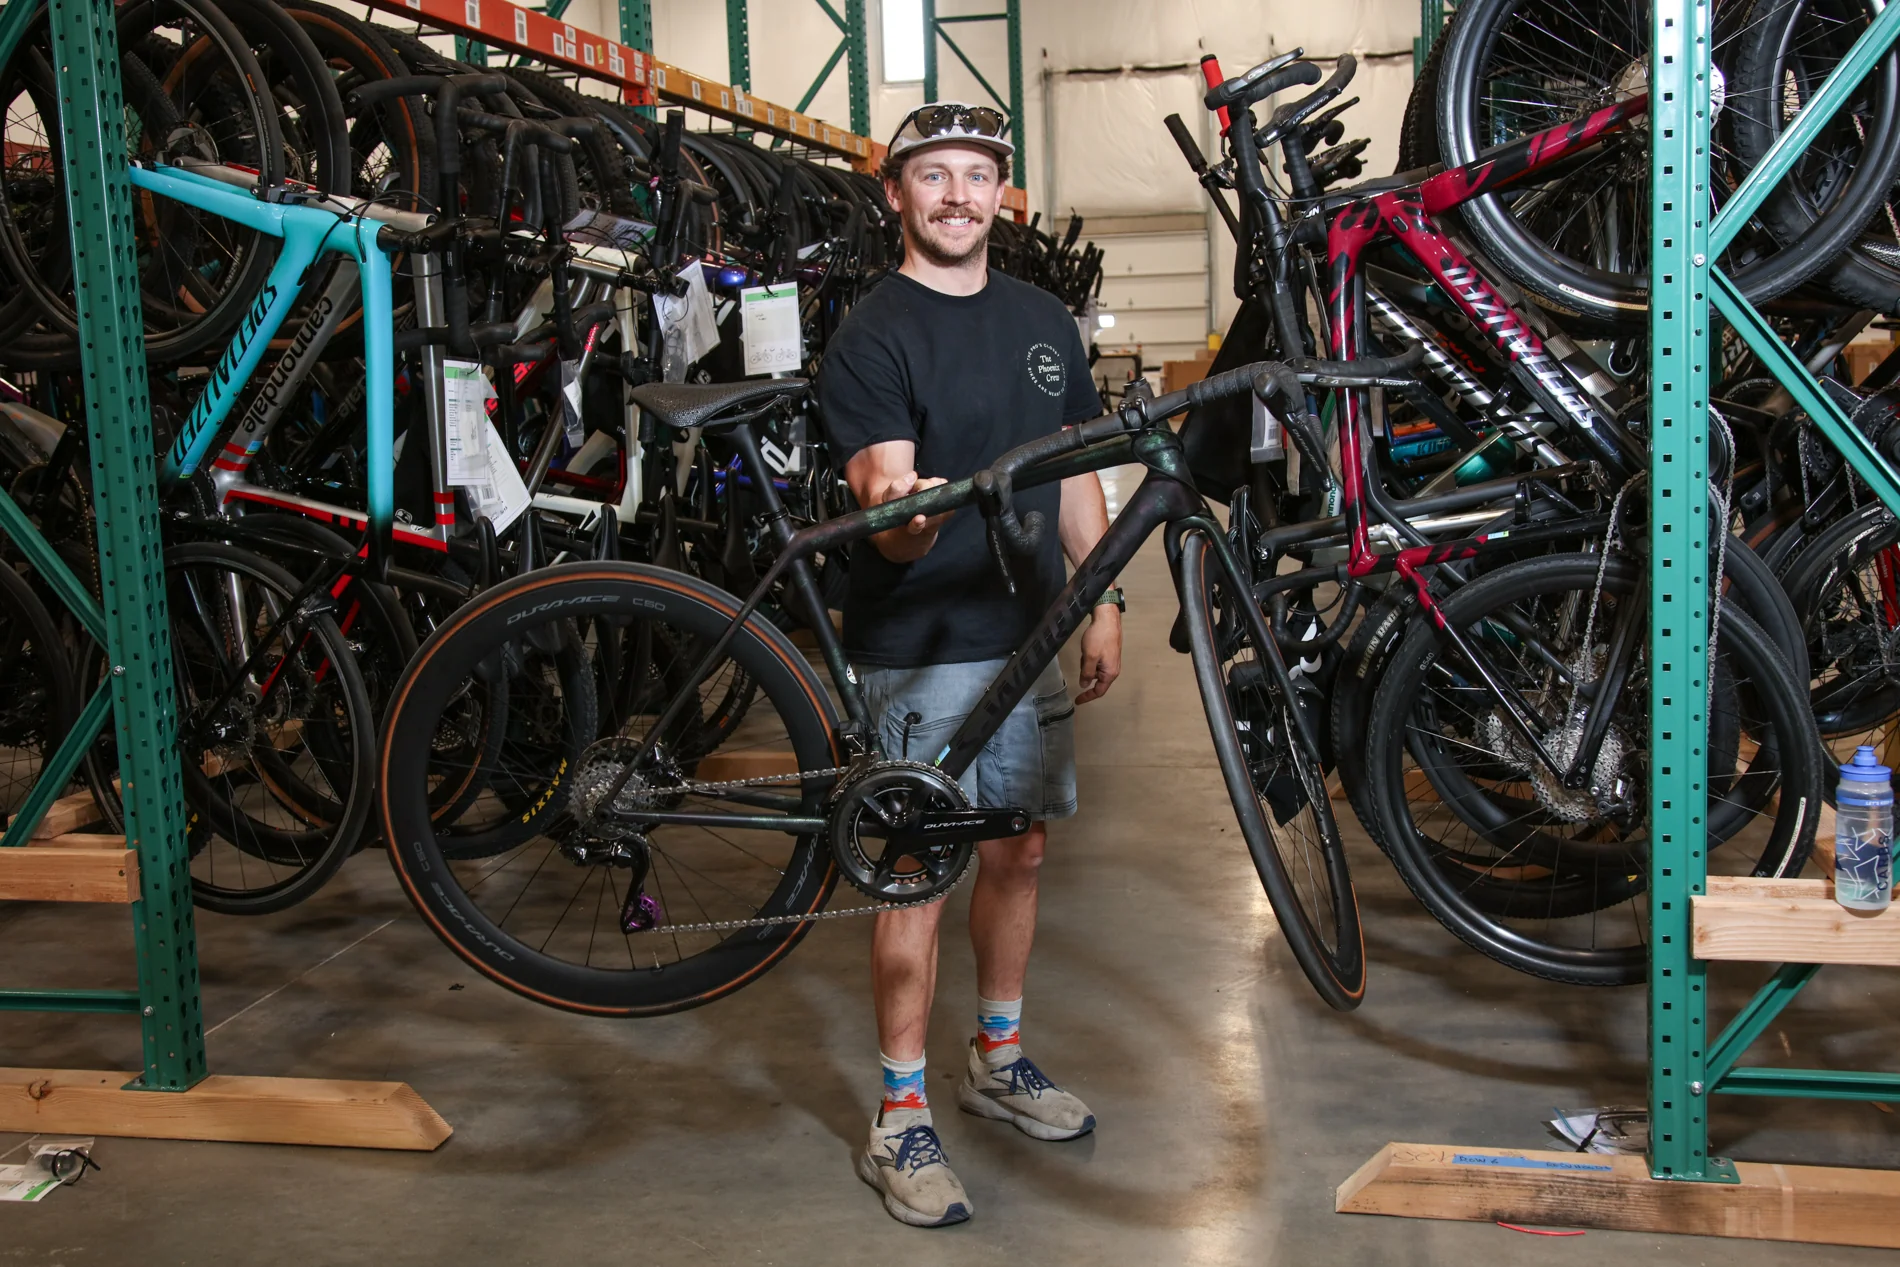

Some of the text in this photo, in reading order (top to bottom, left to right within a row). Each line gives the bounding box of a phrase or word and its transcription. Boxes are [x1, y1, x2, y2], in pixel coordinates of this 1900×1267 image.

[1292, 94, 1330, 125] ULTEGRA
[242, 296, 333, 433] cannondale
[1037, 363, 1060, 374] Phoenix
[1040, 355, 1052, 363] The
[1441, 266, 1598, 428] SPECIALIZED
[173, 279, 278, 467] SPECIALIZED
[1046, 373, 1060, 383] Crew
[507, 595, 667, 625] DURA-ACE C50
[522, 756, 568, 824] MAXXIS
[924, 819, 986, 829] DURA-ACE
[1877, 836, 1890, 891] CARBS
[431, 881, 516, 962] DURA-ACE
